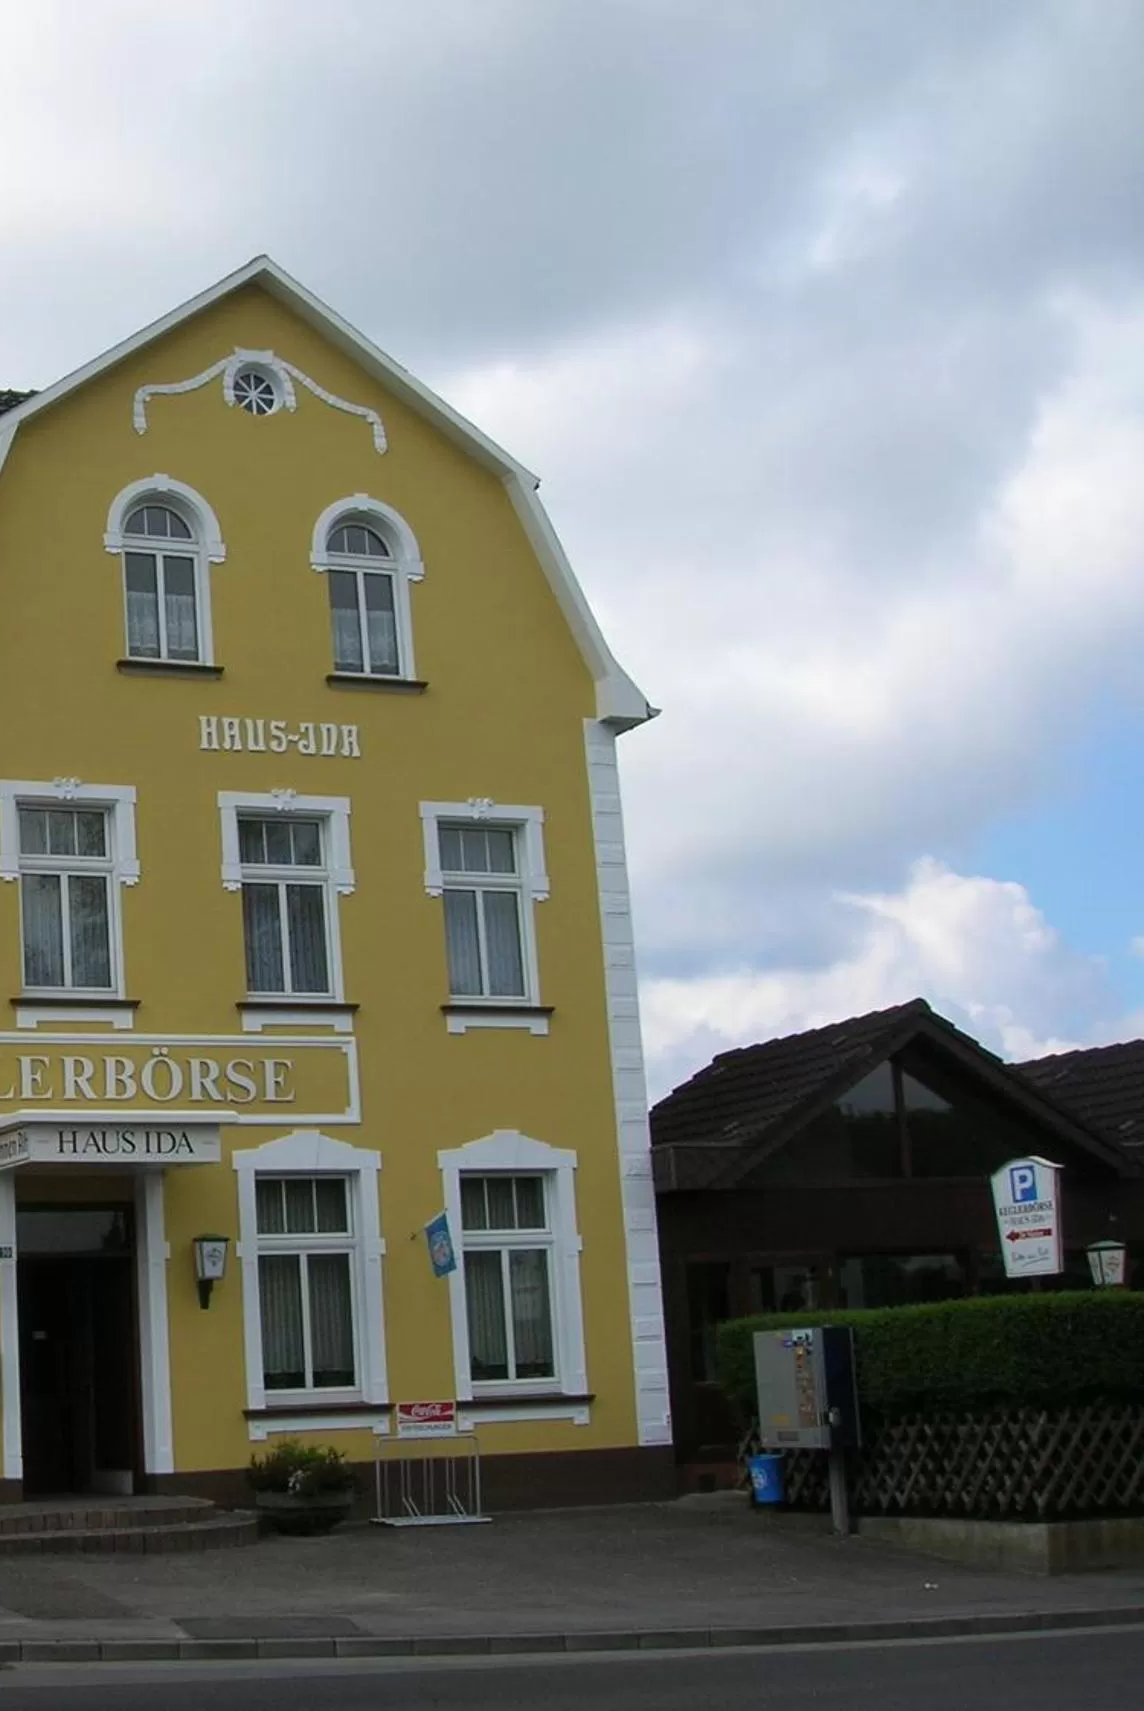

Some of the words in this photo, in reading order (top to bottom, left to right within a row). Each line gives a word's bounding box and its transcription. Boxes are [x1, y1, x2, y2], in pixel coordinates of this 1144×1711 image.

[57, 1130, 136, 1153] HAUS
[145, 1131, 195, 1153] IDA
[1013, 1168, 1034, 1200] P
